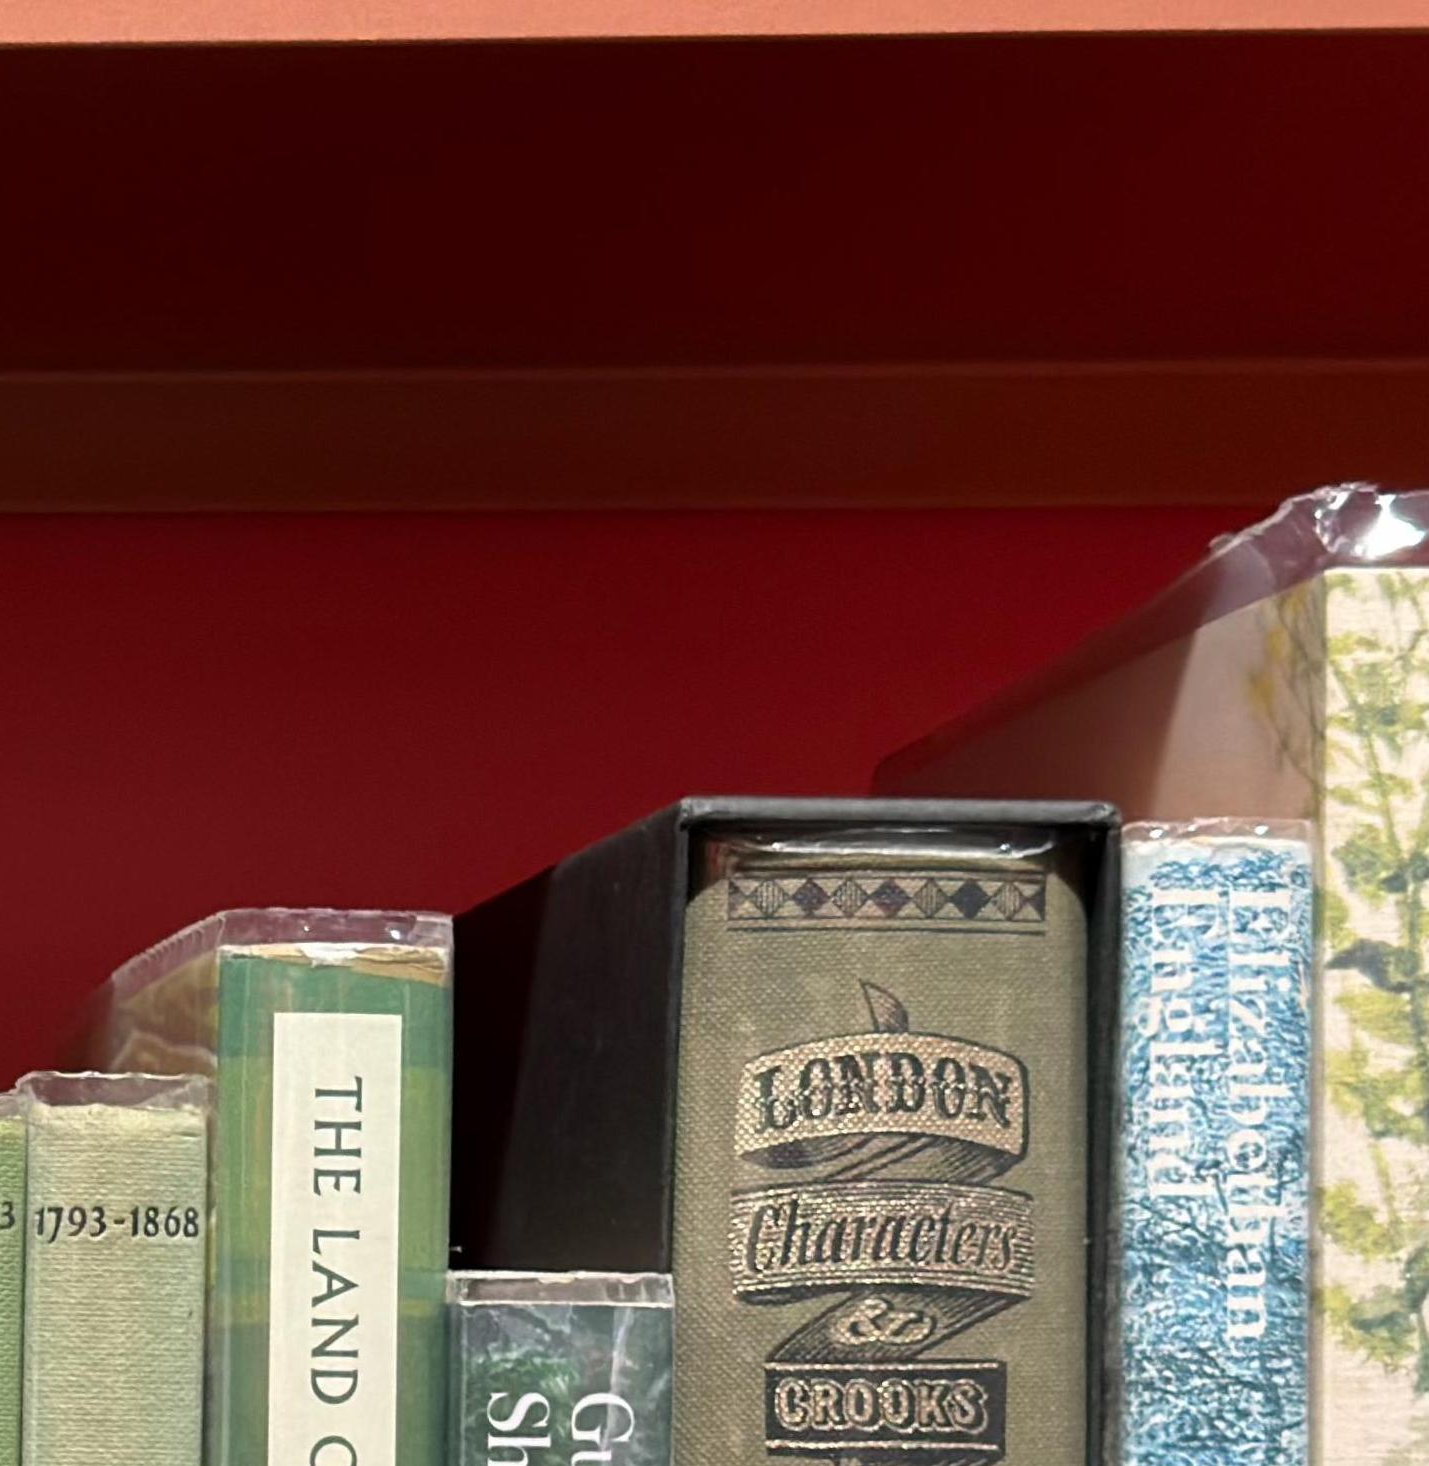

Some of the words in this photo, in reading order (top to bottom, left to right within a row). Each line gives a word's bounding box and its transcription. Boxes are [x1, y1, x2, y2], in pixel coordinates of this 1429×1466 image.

[753, 1052, 1011, 1133] LONDON
[1137, 888, 1227, 1199] England
[312, 1077, 363, 1195] THE
[1229, 889, 1294, 1340] Elizabethan
[36, 1205, 200, 1243] 1793-1868
[746, 1200, 1016, 1275] Characters
[309, 1228, 361, 1405] LAND
[775, 1378, 988, 1435] CROOKS
